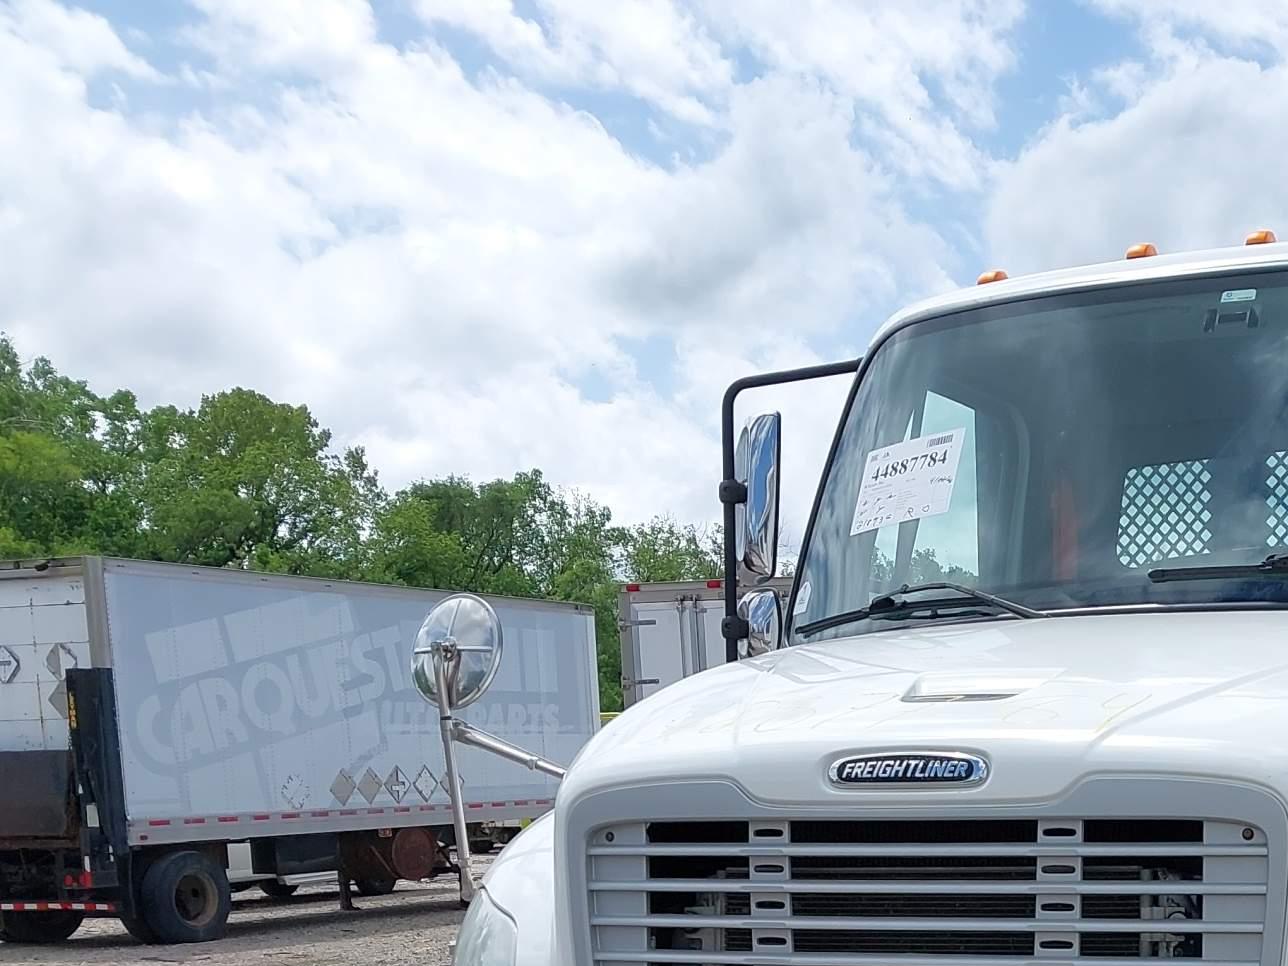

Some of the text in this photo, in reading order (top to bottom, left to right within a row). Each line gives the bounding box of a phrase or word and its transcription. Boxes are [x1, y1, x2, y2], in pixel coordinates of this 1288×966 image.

[871, 449, 948, 481] 44887784
[136, 625, 410, 766] CARQUEST
[841, 759, 969, 779] FREIGHTLINER
